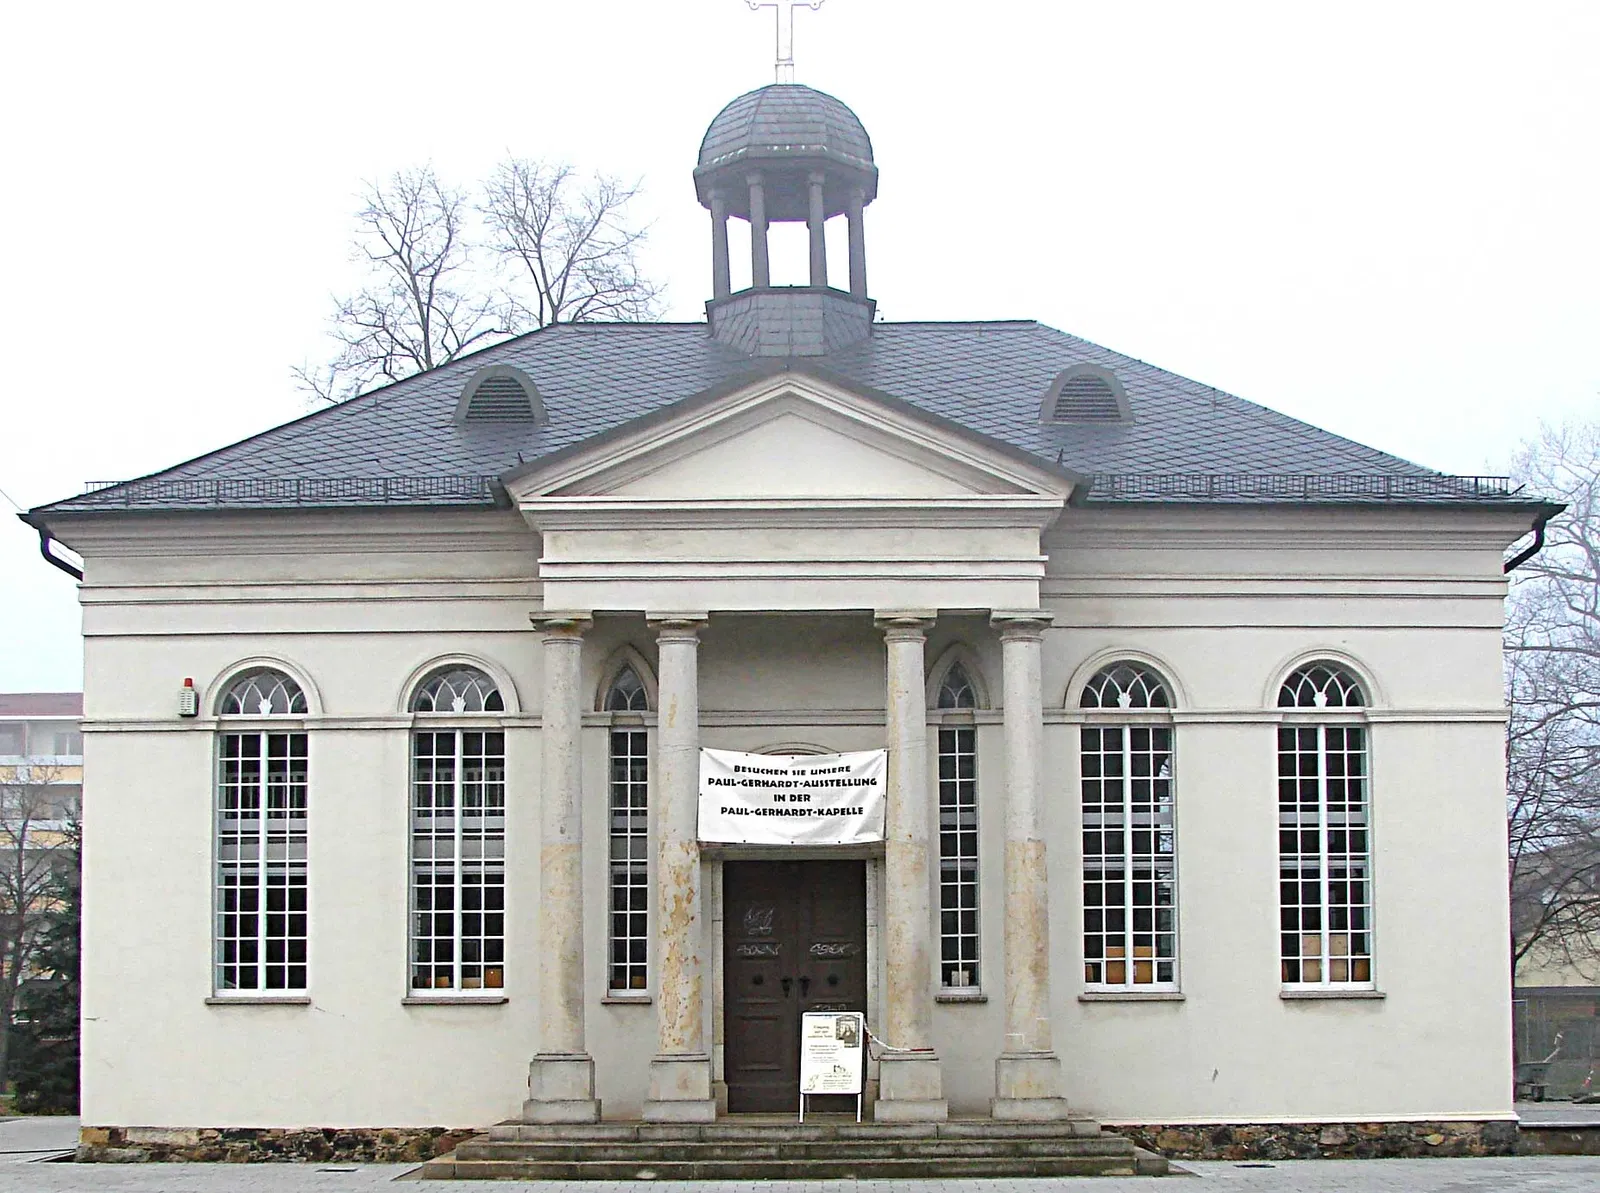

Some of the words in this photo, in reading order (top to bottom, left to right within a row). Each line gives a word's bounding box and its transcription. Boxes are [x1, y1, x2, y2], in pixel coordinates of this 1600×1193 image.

[734, 765, 788, 776] BESUCHEN
[811, 765, 851, 775] UNSERE
[708, 777, 877, 788] PAUL-GERHARDT-AUSSTELLUNG
[773, 794, 786, 802] IN
[790, 794, 811, 802] DER
[720, 806, 864, 816] PAUL-GERHARDT-KAPELLE
